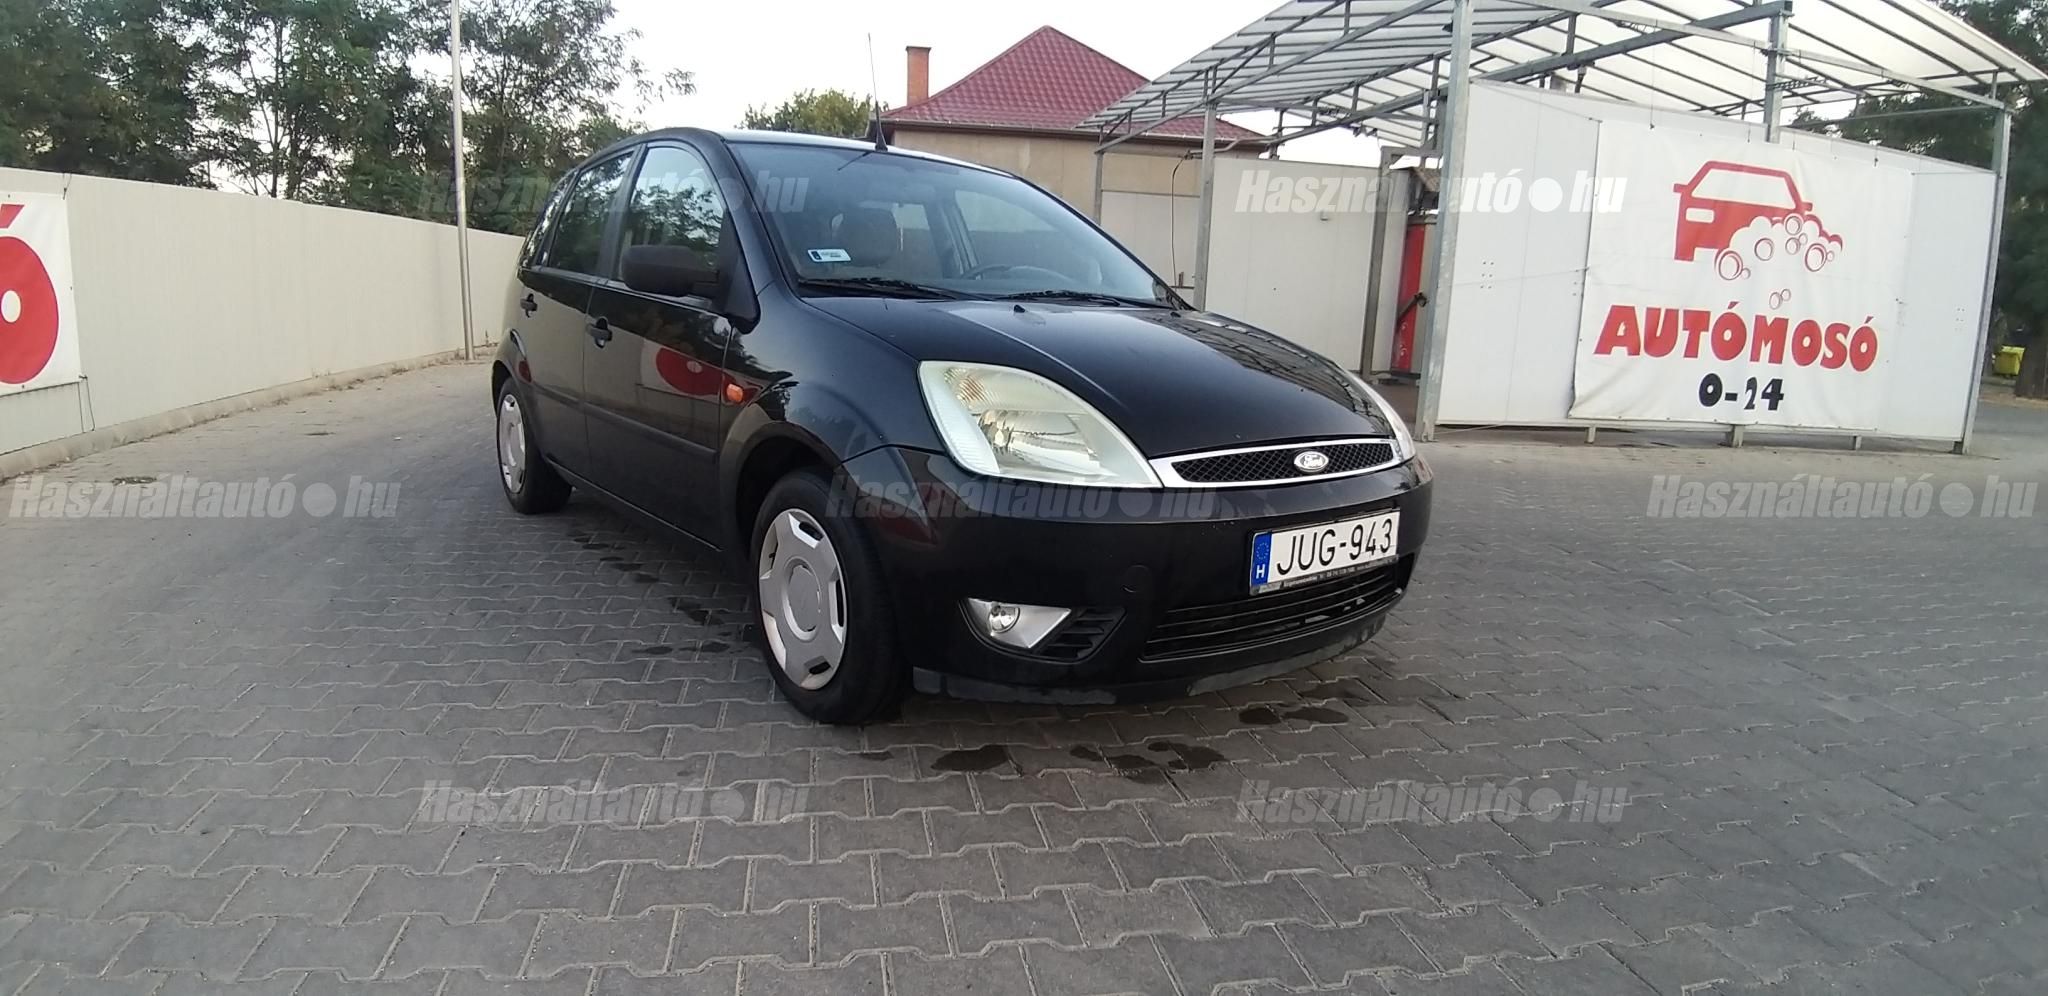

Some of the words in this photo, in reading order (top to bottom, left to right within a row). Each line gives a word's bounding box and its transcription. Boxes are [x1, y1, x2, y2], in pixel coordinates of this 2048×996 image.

[1593, 301, 1878, 372] AUTÓMOSÓ
[1256, 564, 1266, 579] H
[1277, 518, 1392, 575] JUG-943
